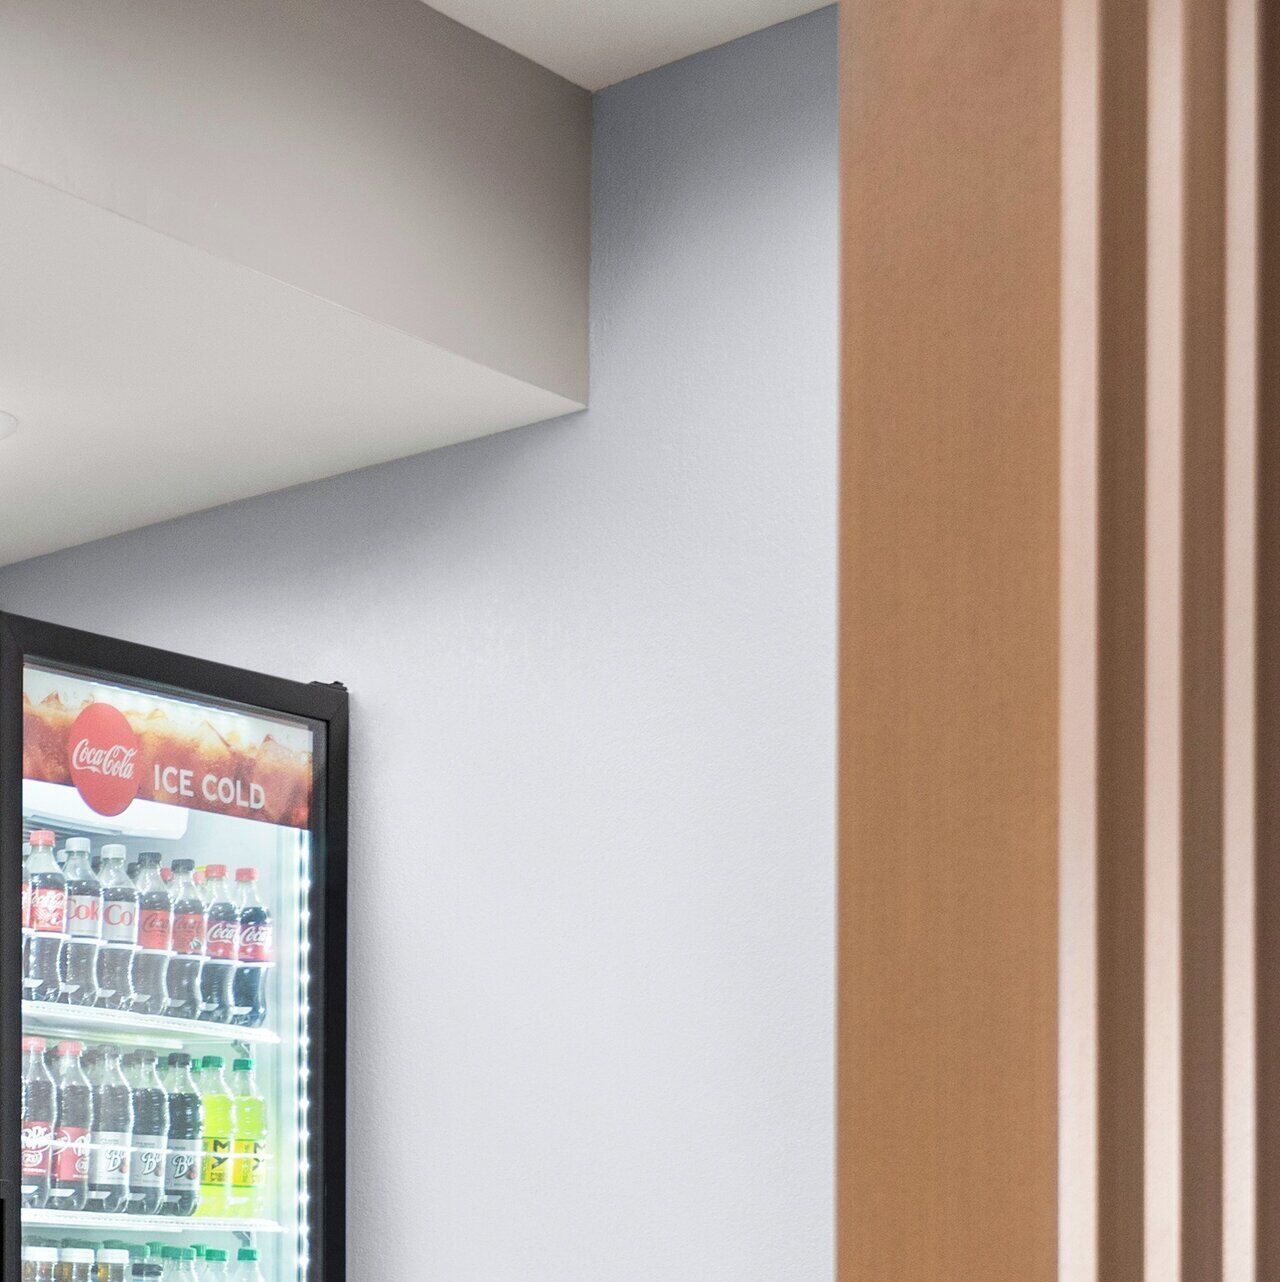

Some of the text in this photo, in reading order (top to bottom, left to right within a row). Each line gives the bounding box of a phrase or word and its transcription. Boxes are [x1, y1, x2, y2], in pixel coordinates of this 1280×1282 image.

[72, 738, 138, 780] Coca-Cola
[153, 764, 266, 810] ICE COLD
